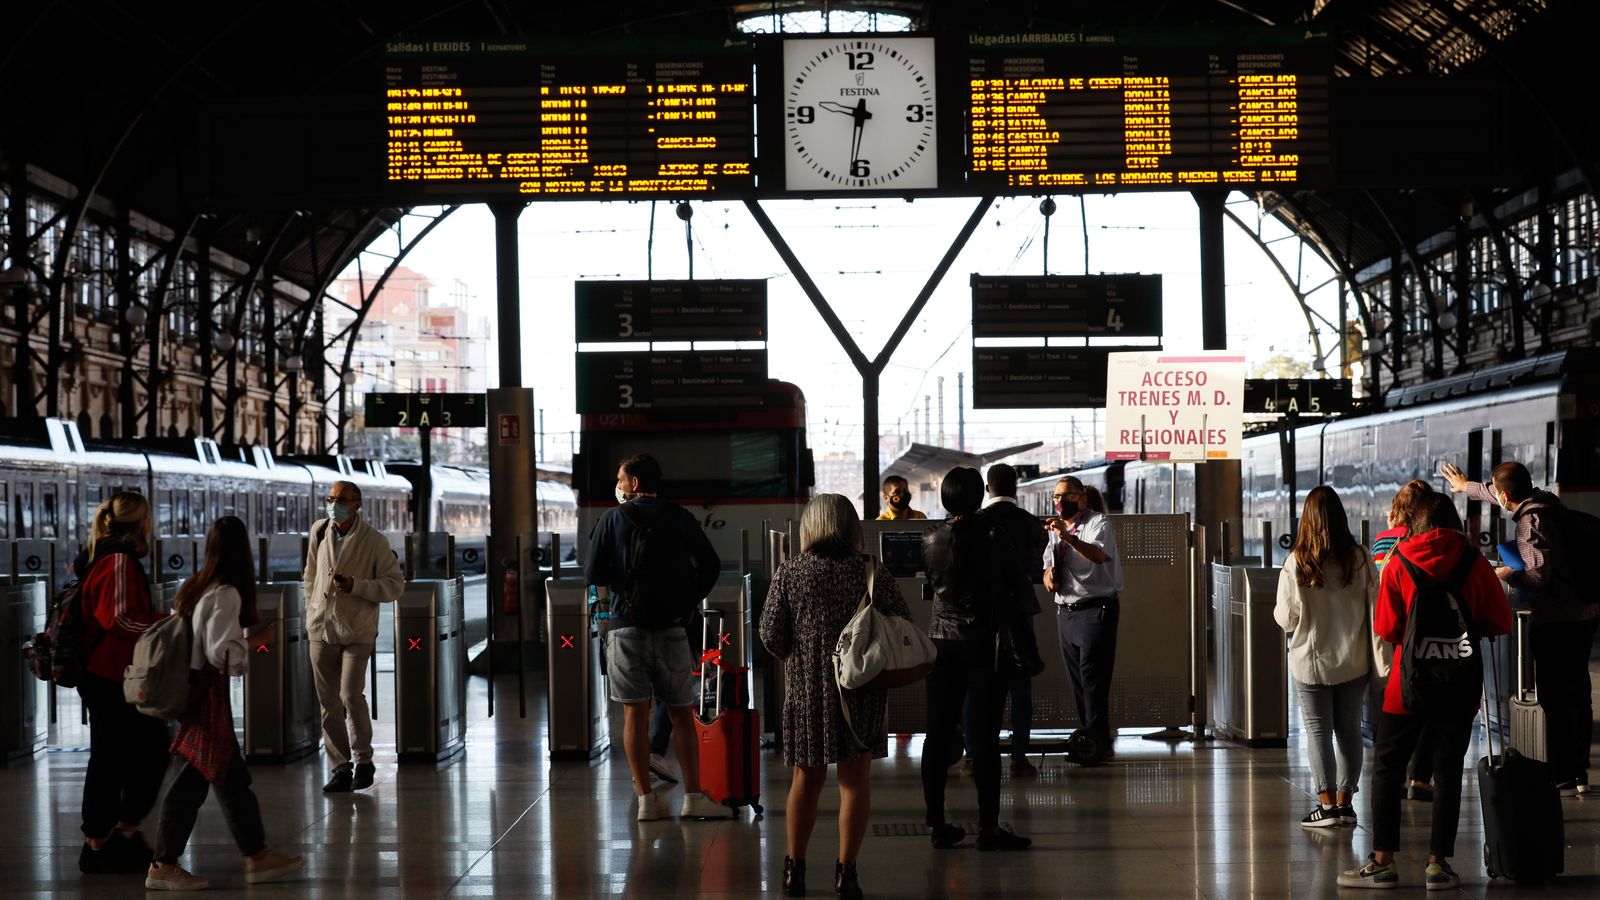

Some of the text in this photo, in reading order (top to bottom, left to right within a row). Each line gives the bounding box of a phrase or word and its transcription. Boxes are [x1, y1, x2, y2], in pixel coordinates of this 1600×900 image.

[969, 34, 1017, 45] Llegadas
[1022, 33, 1076, 43] ARRIBADES
[386, 42, 424, 53] Salidas
[432, 42, 471, 52] EIXIDES
[845, 52, 874, 70] 12
[840, 88, 880, 96] FESTINA
[797, 106, 815, 124] 9
[906, 104, 924, 123] 3
[852, 160, 870, 178] 6
[618, 313, 633, 337] 3
[1106, 308, 1124, 332] 4
[1141, 371, 1207, 387] ACCESO
[618, 384, 633, 409] 3
[1118, 390, 1231, 406] TRENES M. D.
[1264, 397, 1320, 412] 4 A 5
[398, 411, 451, 427] 2 A 3
[1168, 410, 1179, 425] Y
[1120, 429, 1227, 445] REGIONALES
[1414, 631, 1474, 660] VANS
